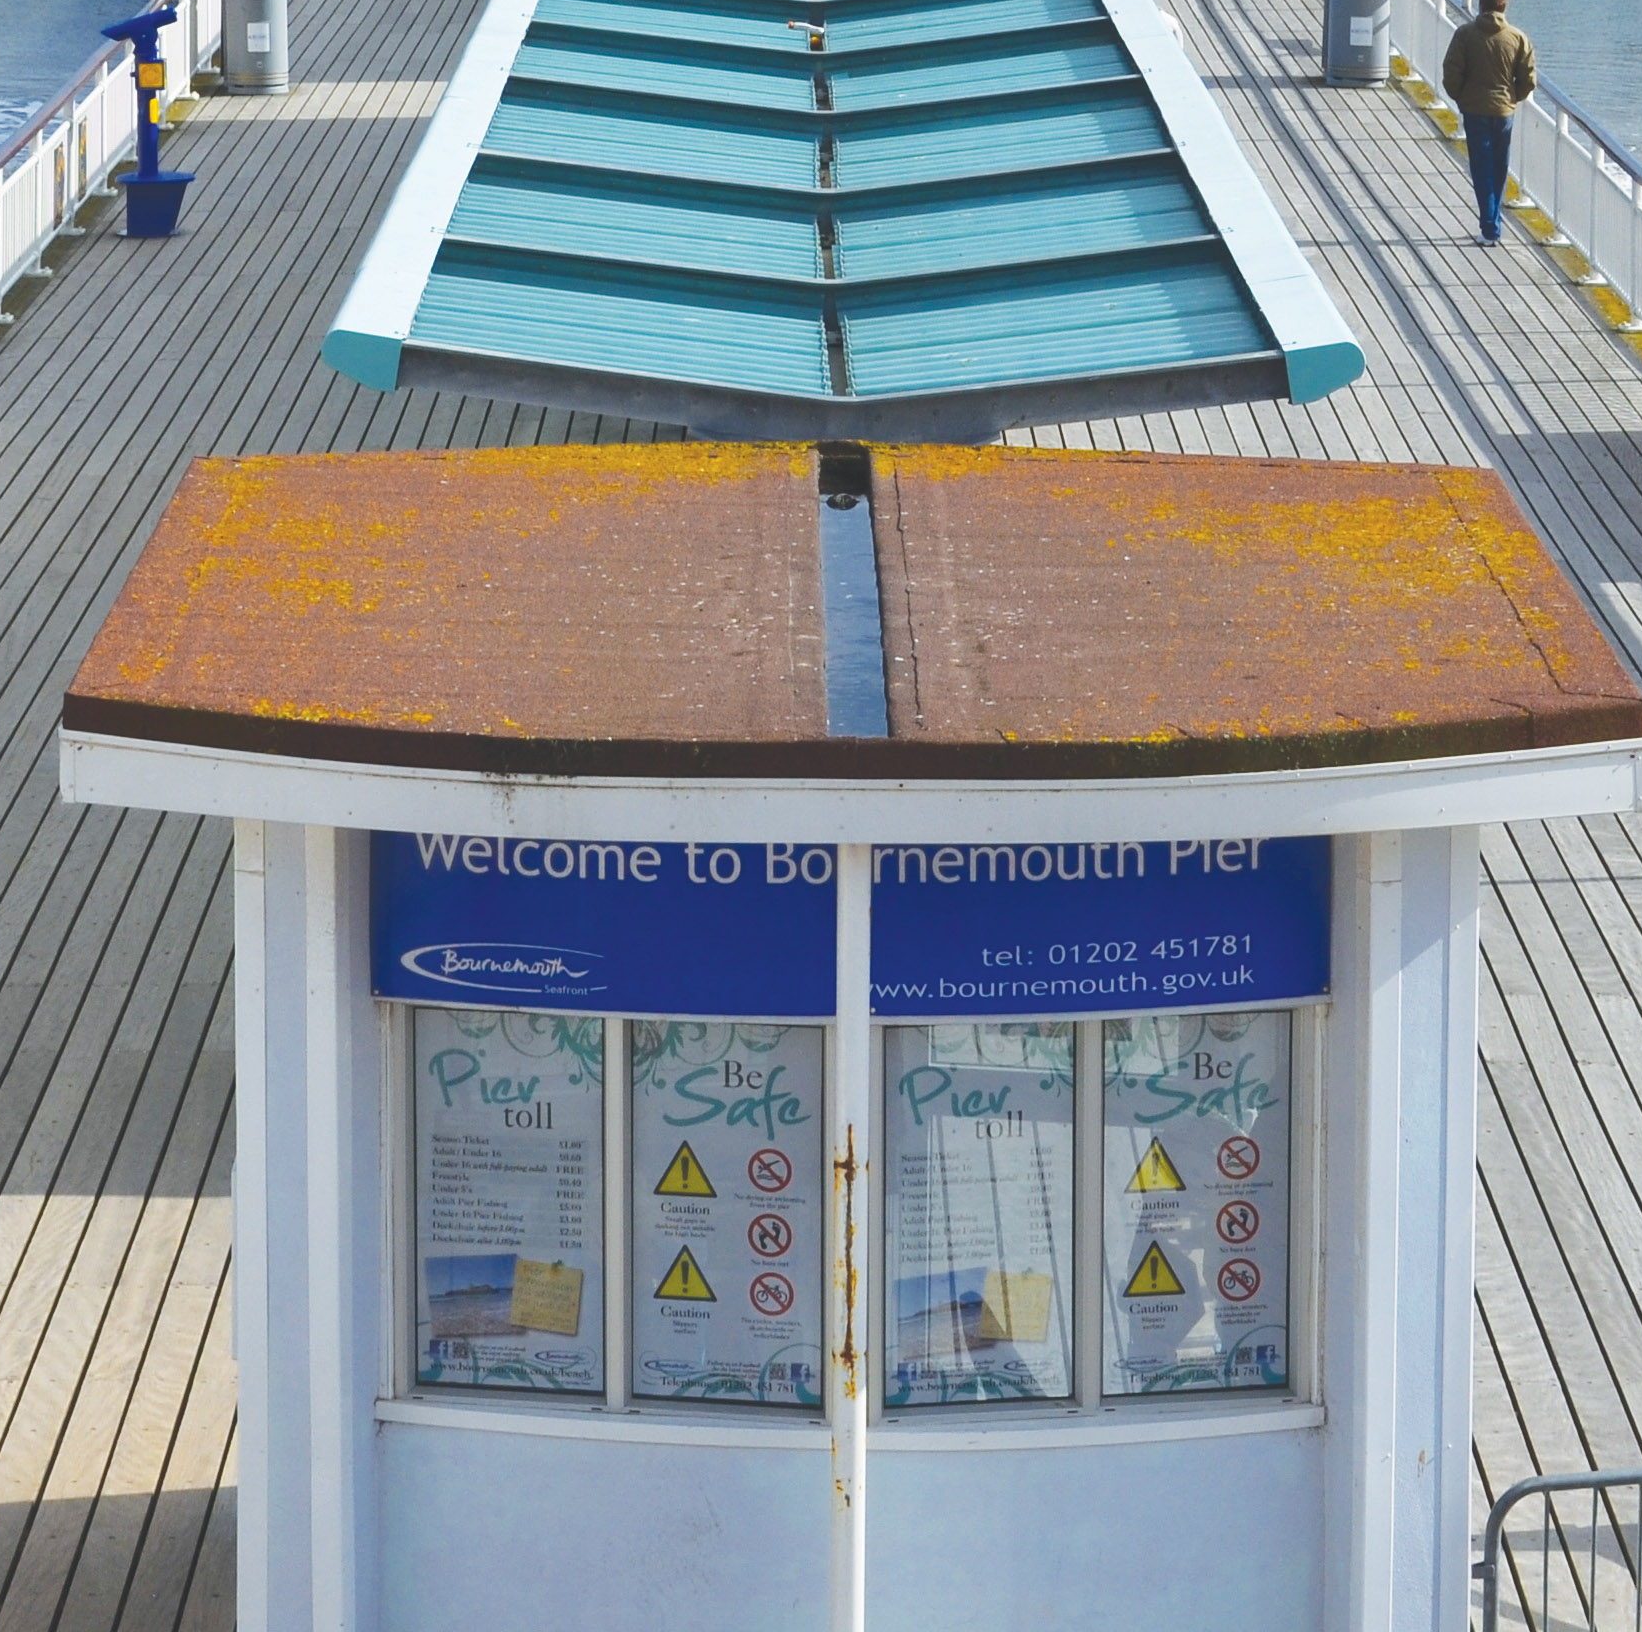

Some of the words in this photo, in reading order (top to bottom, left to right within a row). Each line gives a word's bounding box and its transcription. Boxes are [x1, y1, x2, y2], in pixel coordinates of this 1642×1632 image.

[415, 832, 662, 882] Welcome
[685, 841, 742, 885] to
[766, 841, 1145, 886] Bornemouth
[1169, 837, 1271, 875] Pier
[441, 949, 589, 978] Bournemouth
[982, 946, 1034, 967] tel:
[1049, 941, 1138, 965] 01202
[1151, 934, 1252, 960] 451781
[544, 984, 589, 996] Seafront
[429, 1048, 540, 1107] Pier
[723, 1060, 763, 1090] Be
[1193, 1052, 1233, 1080] Be
[663, 1064, 812, 1141] Safe
[899, 1063, 1011, 1126] Pier
[1134, 1053, 1279, 1131] Safe
[504, 1101, 554, 1129] toll
[975, 1110, 1023, 1139] toll
[660, 1202, 710, 1216] Caution
[1131, 1198, 1180, 1211] Caution
[660, 1305, 710, 1319] Caution
[1129, 1302, 1179, 1315] Caution
[777, 1382, 794, 1393] 781
